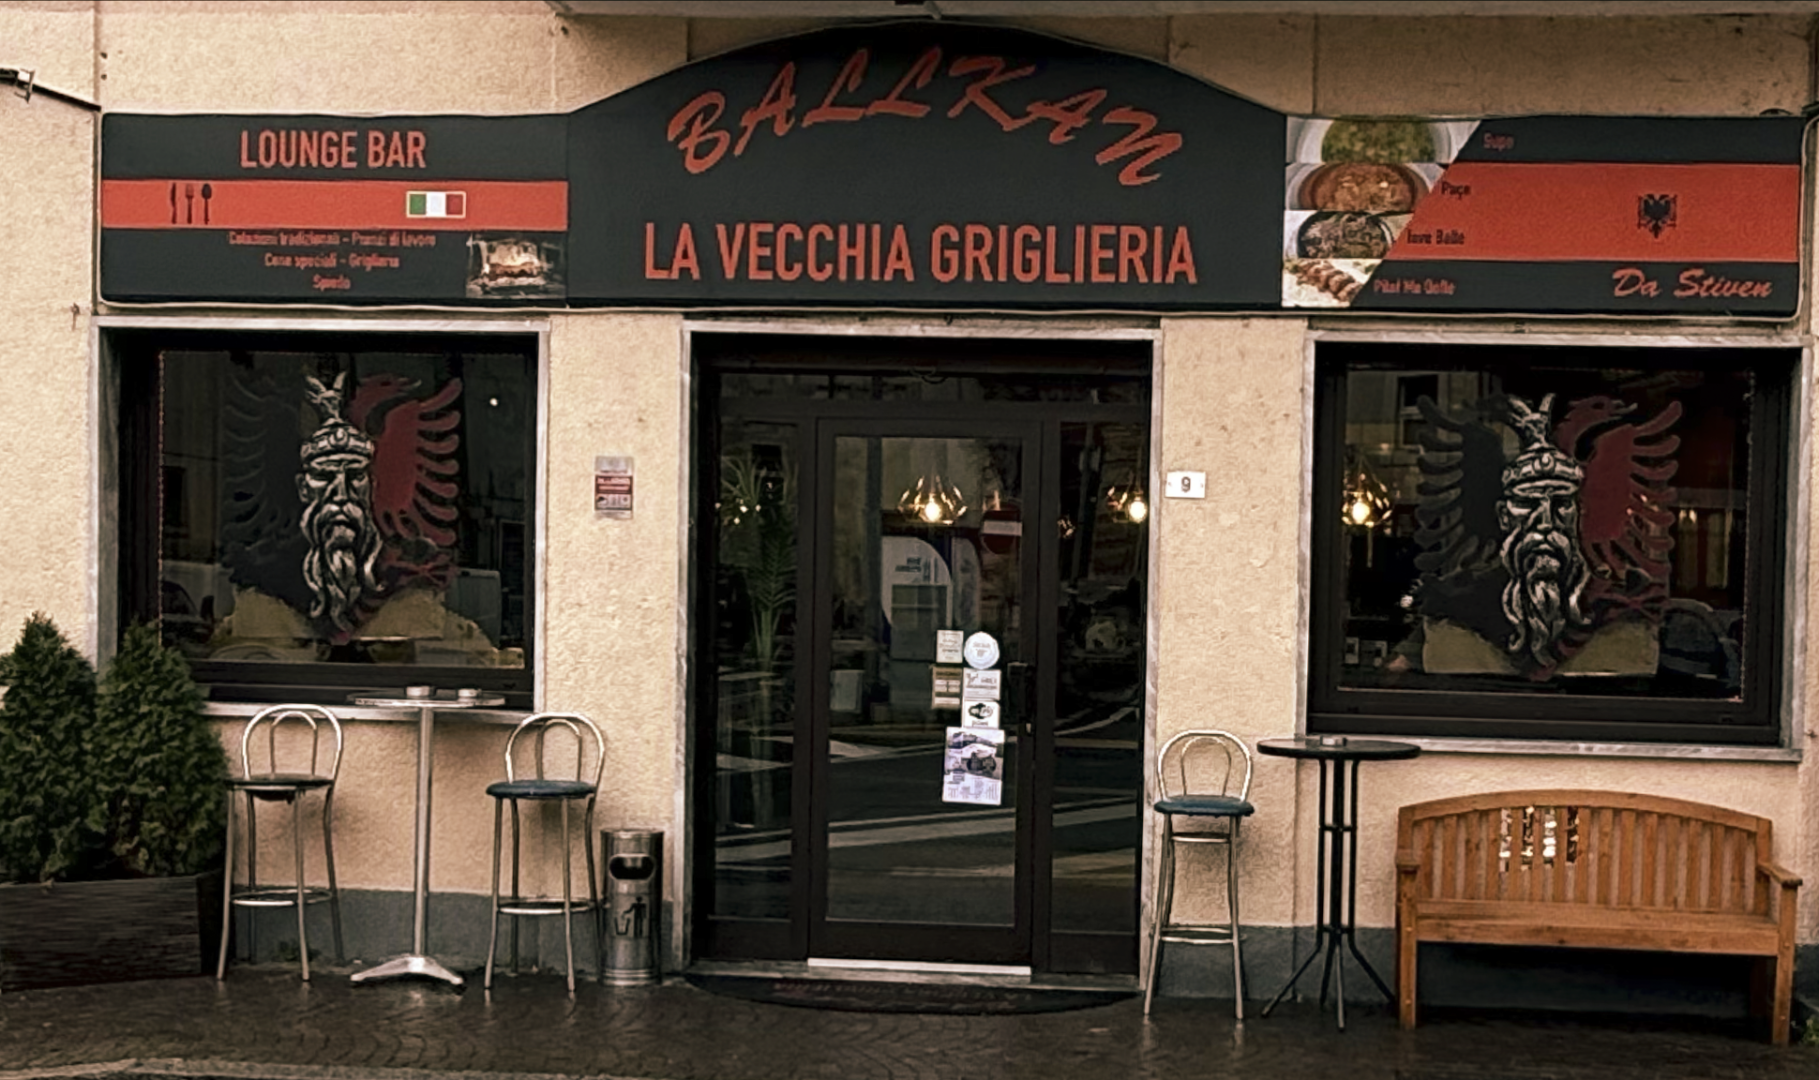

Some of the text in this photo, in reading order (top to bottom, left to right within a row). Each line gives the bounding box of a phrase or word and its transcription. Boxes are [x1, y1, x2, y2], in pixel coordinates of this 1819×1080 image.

[667, 47, 1183, 187] BALLKAN
[240, 130, 428, 169] LOUNGE BAR
[644, 222, 1198, 284] LA VECCHIA GRIGLIERIA
[1612, 267, 1773, 298] Da Stiven
[1181, 476, 1191, 493] 9
